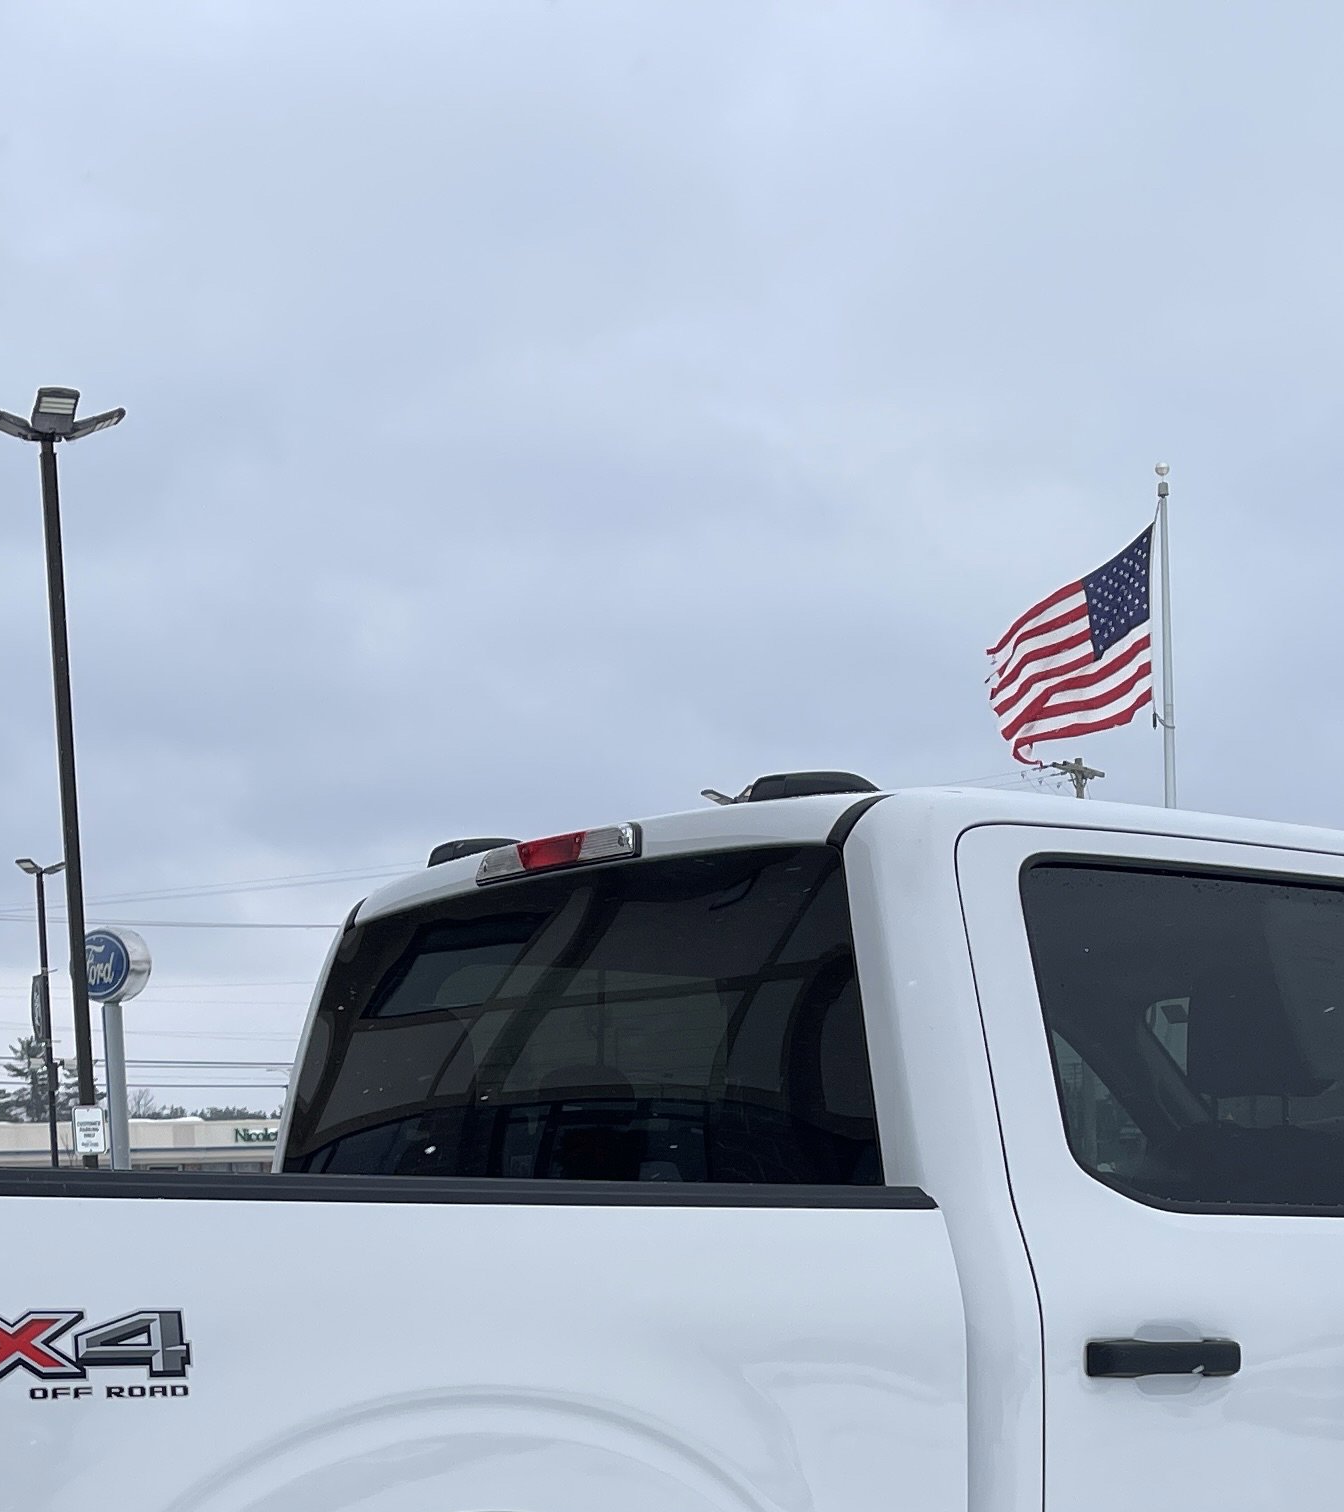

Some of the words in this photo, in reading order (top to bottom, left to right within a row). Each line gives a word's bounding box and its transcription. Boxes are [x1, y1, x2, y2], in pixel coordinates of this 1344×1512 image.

[235, 1127, 278, 1142] Nicole
[29, 1386, 93, 1400] OFF
[105, 1383, 189, 1399] ROAD
